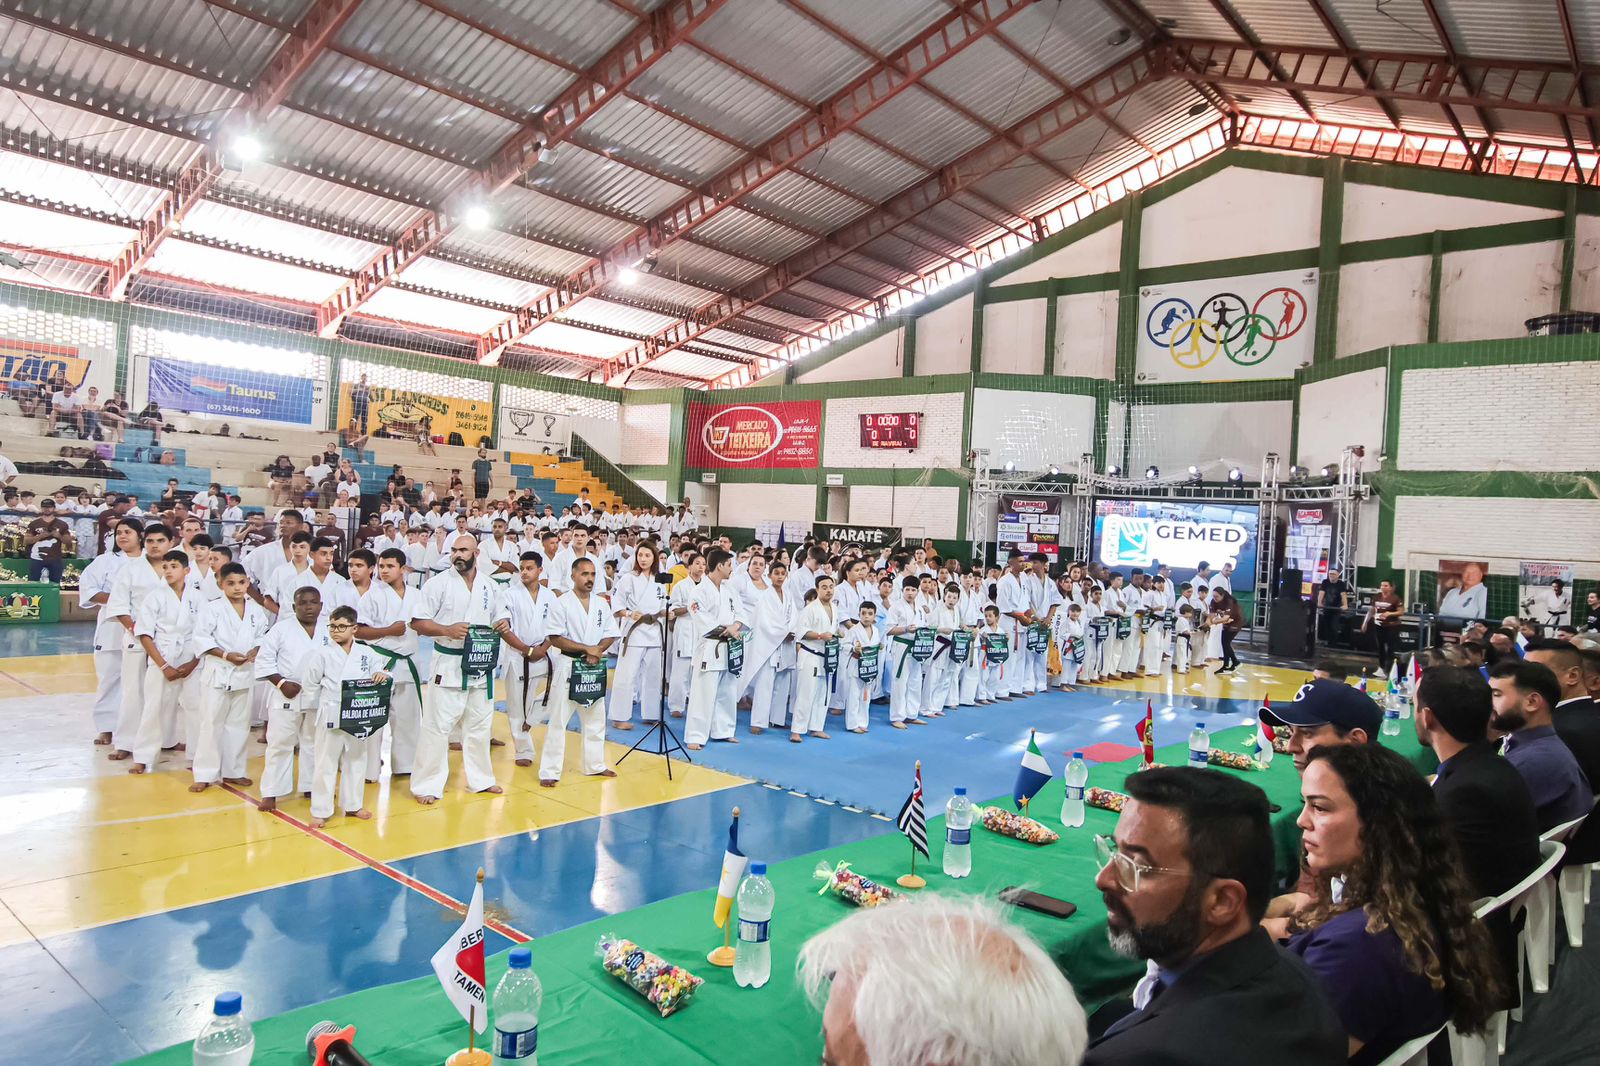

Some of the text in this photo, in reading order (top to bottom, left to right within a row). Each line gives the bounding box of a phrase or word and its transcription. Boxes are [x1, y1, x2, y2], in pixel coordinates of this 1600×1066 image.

[229, 384, 277, 400] Taurus
[736, 420, 769, 431] MERCADO
[866, 416, 873, 426] 0
[909, 415, 917, 426] 0
[728, 432, 771, 449] TEIXEIRA
[871, 430, 878, 440] 0
[909, 430, 917, 440] 0
[829, 528, 883, 543] KARATÊ
[1156, 525, 1241, 543] GEMED
[472, 644, 492, 653] DAIDO
[581, 674, 597, 683] DOJO
[575, 683, 602, 692] KAKUSHI
[351, 696, 380, 708] ASSOCIAÇÃO
[342, 709, 361, 719] BALBOA
[362, 709, 369, 718] DE
[454, 970, 486, 1004] TAMEN
